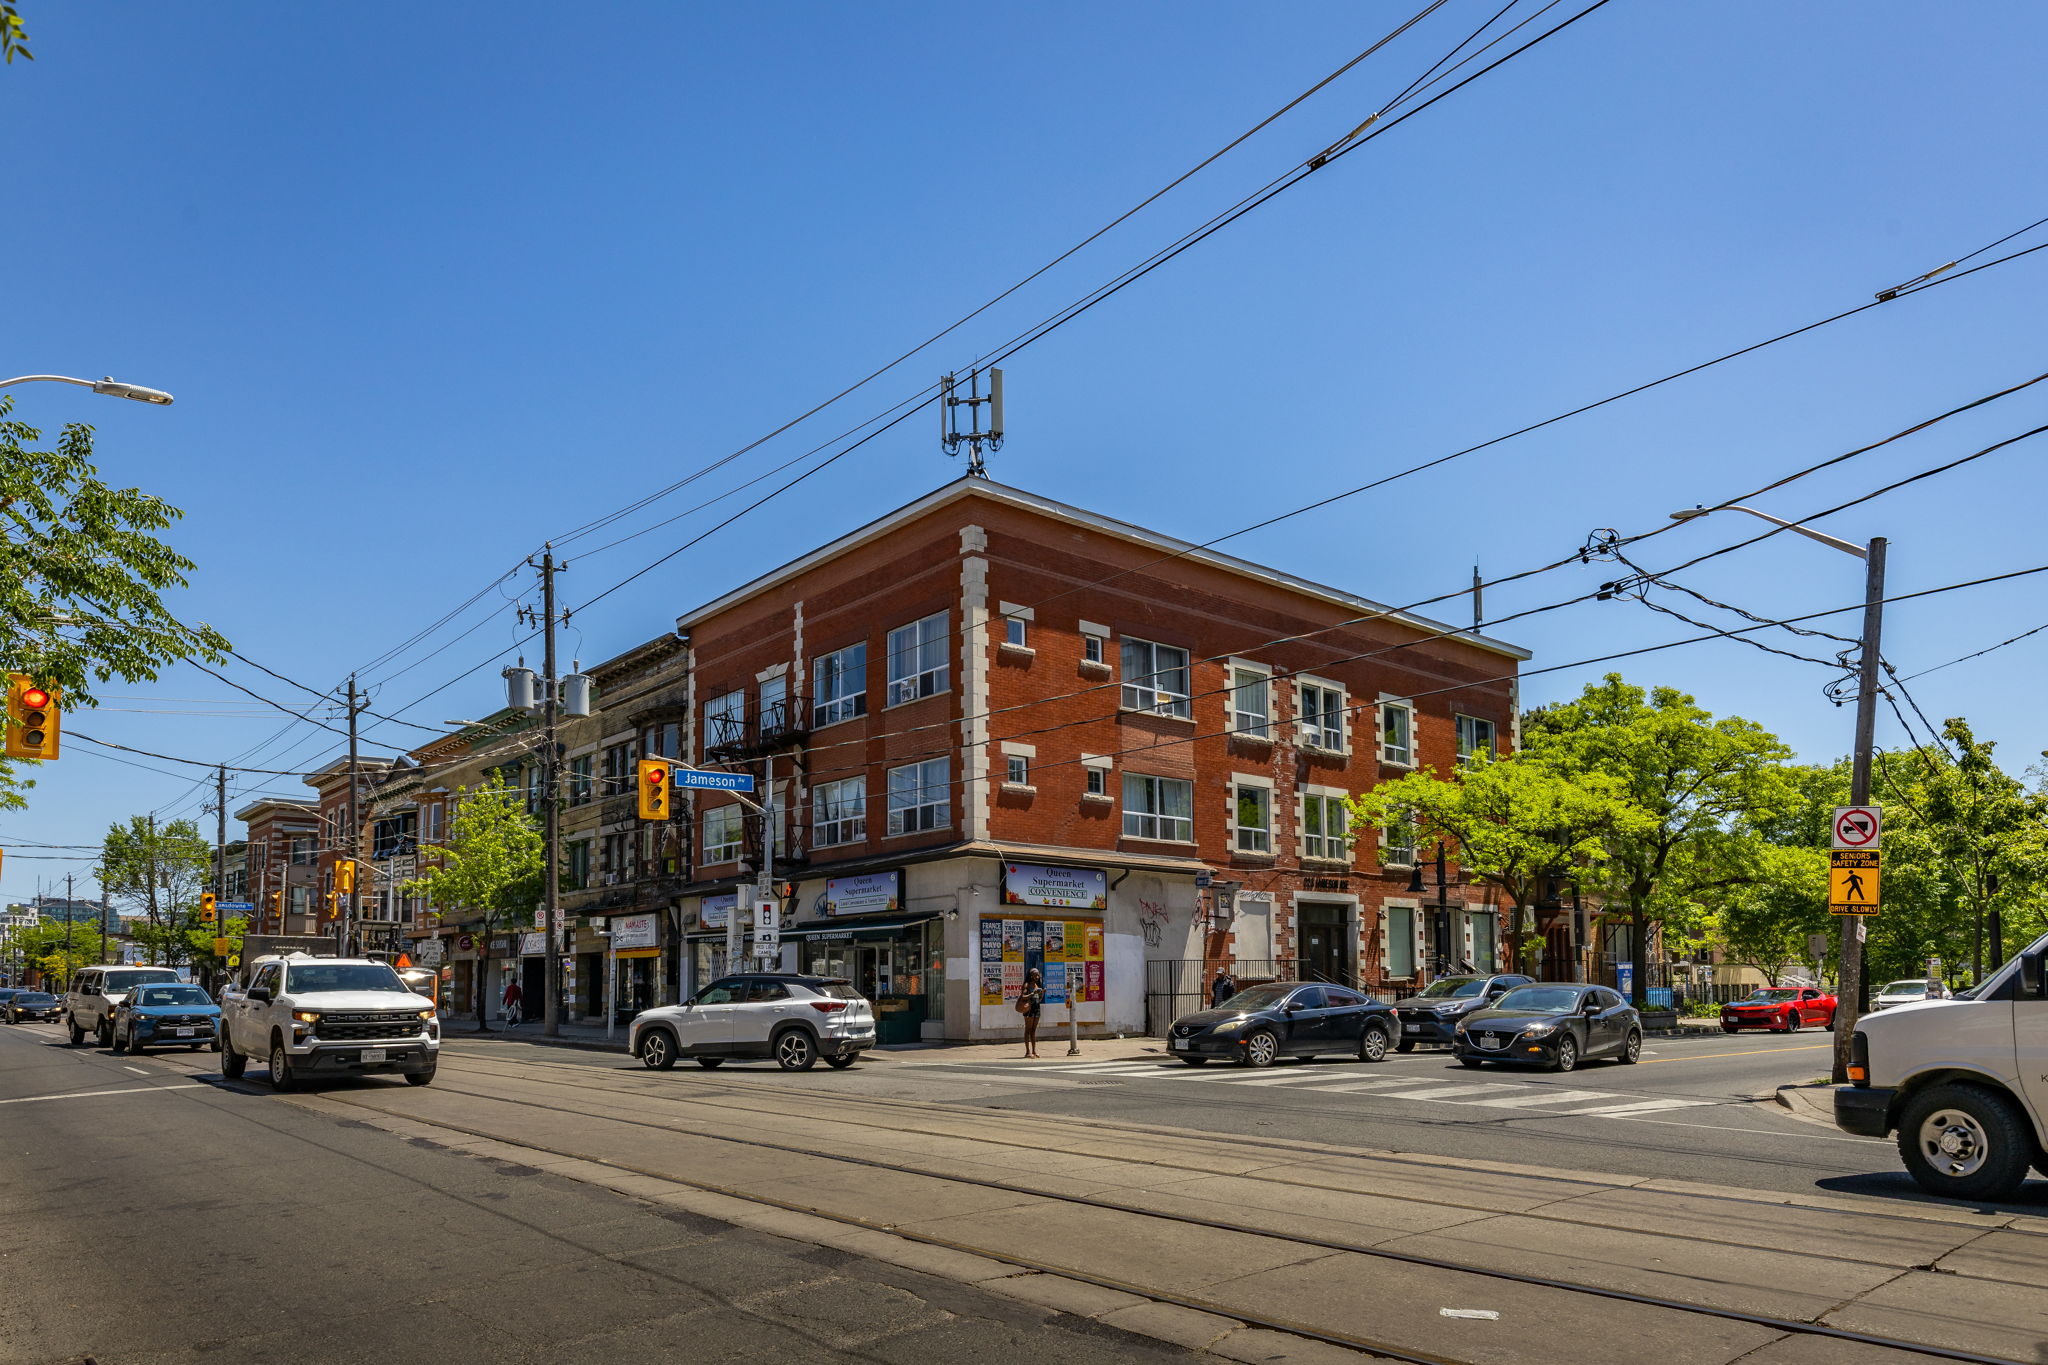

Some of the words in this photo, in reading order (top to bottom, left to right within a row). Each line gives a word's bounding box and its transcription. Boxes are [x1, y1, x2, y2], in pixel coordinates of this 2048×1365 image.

[685, 773, 735, 787] Jameson
[1840, 852, 1870, 860] SENIORS
[1046, 867, 1071, 877] Queen
[853, 877, 872, 886] Queen
[1033, 877, 1085, 889] Supermarket
[844, 885, 882, 897] Supermarket
[1030, 888, 1087, 899] CONVENIENCE
[1852, 905, 1878, 913] SLOWLY
[624, 920, 647, 928] NAMASTE
[806, 934, 820, 942] QUEEN
[822, 932, 853, 940] SUPERMARKET
